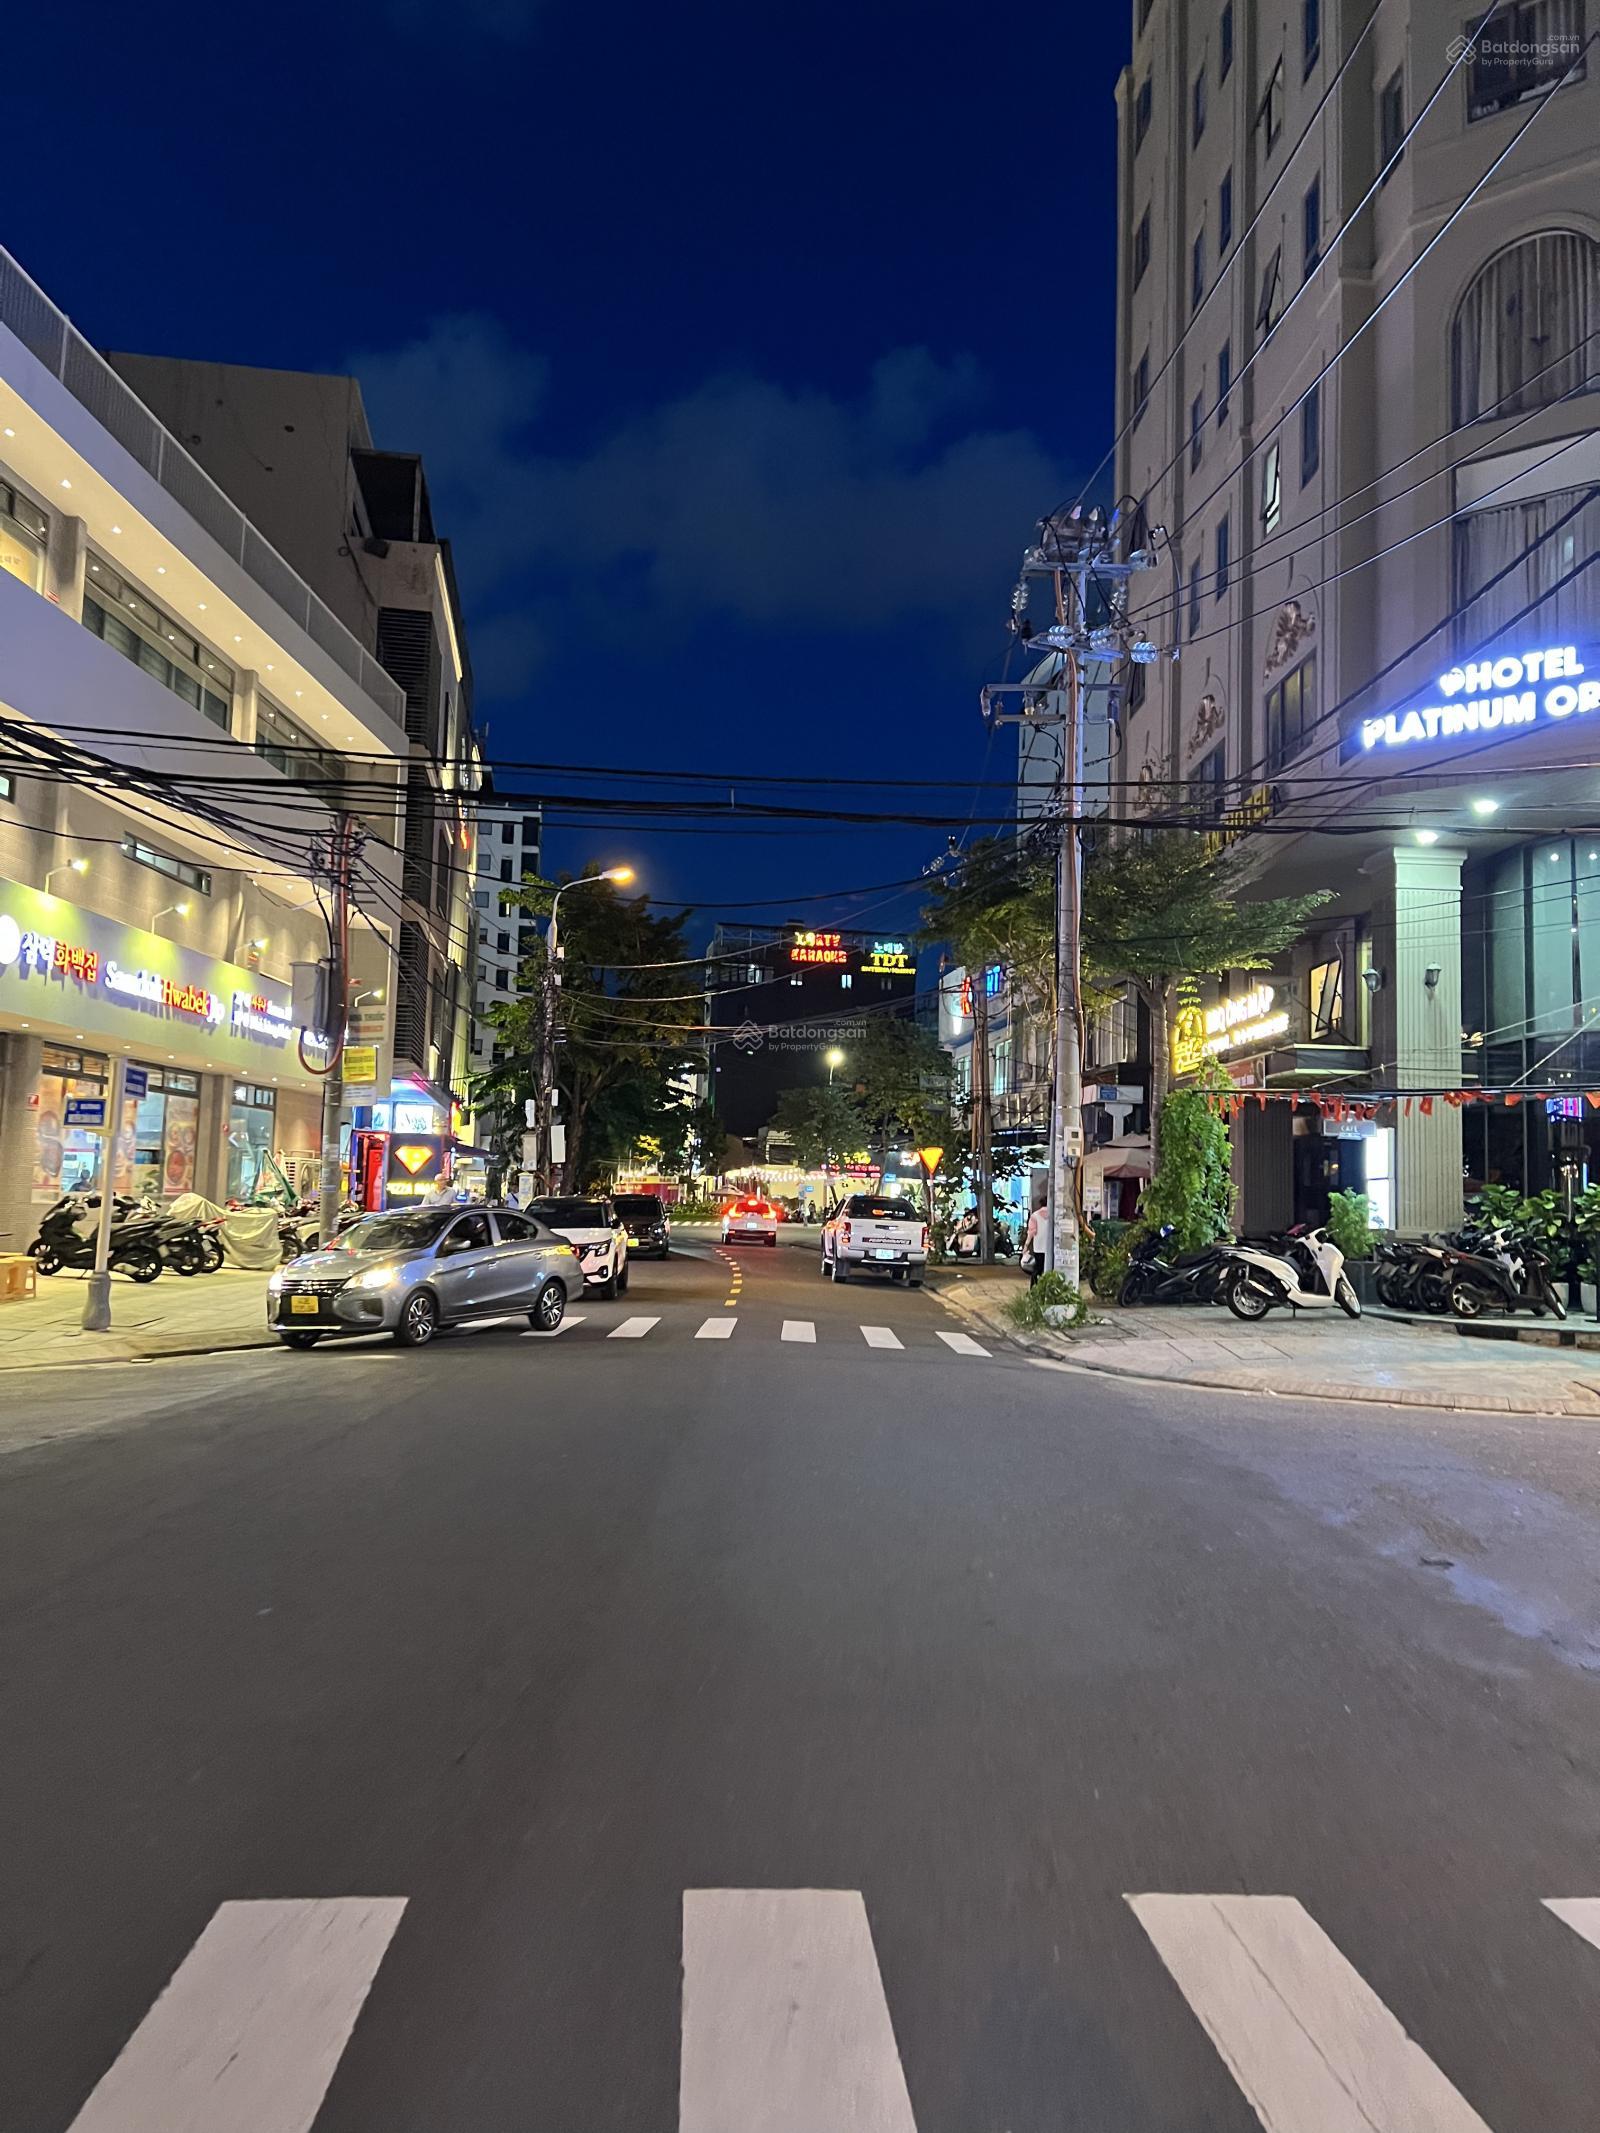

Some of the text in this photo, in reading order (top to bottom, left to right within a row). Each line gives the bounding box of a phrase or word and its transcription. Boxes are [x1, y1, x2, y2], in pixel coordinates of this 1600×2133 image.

[1465, 646, 1585, 694] HOTEL
[1362, 691, 1536, 749] PLATINUM
[791, 948, 848, 963] KARAOKE
[870, 953, 908, 967] TDT
